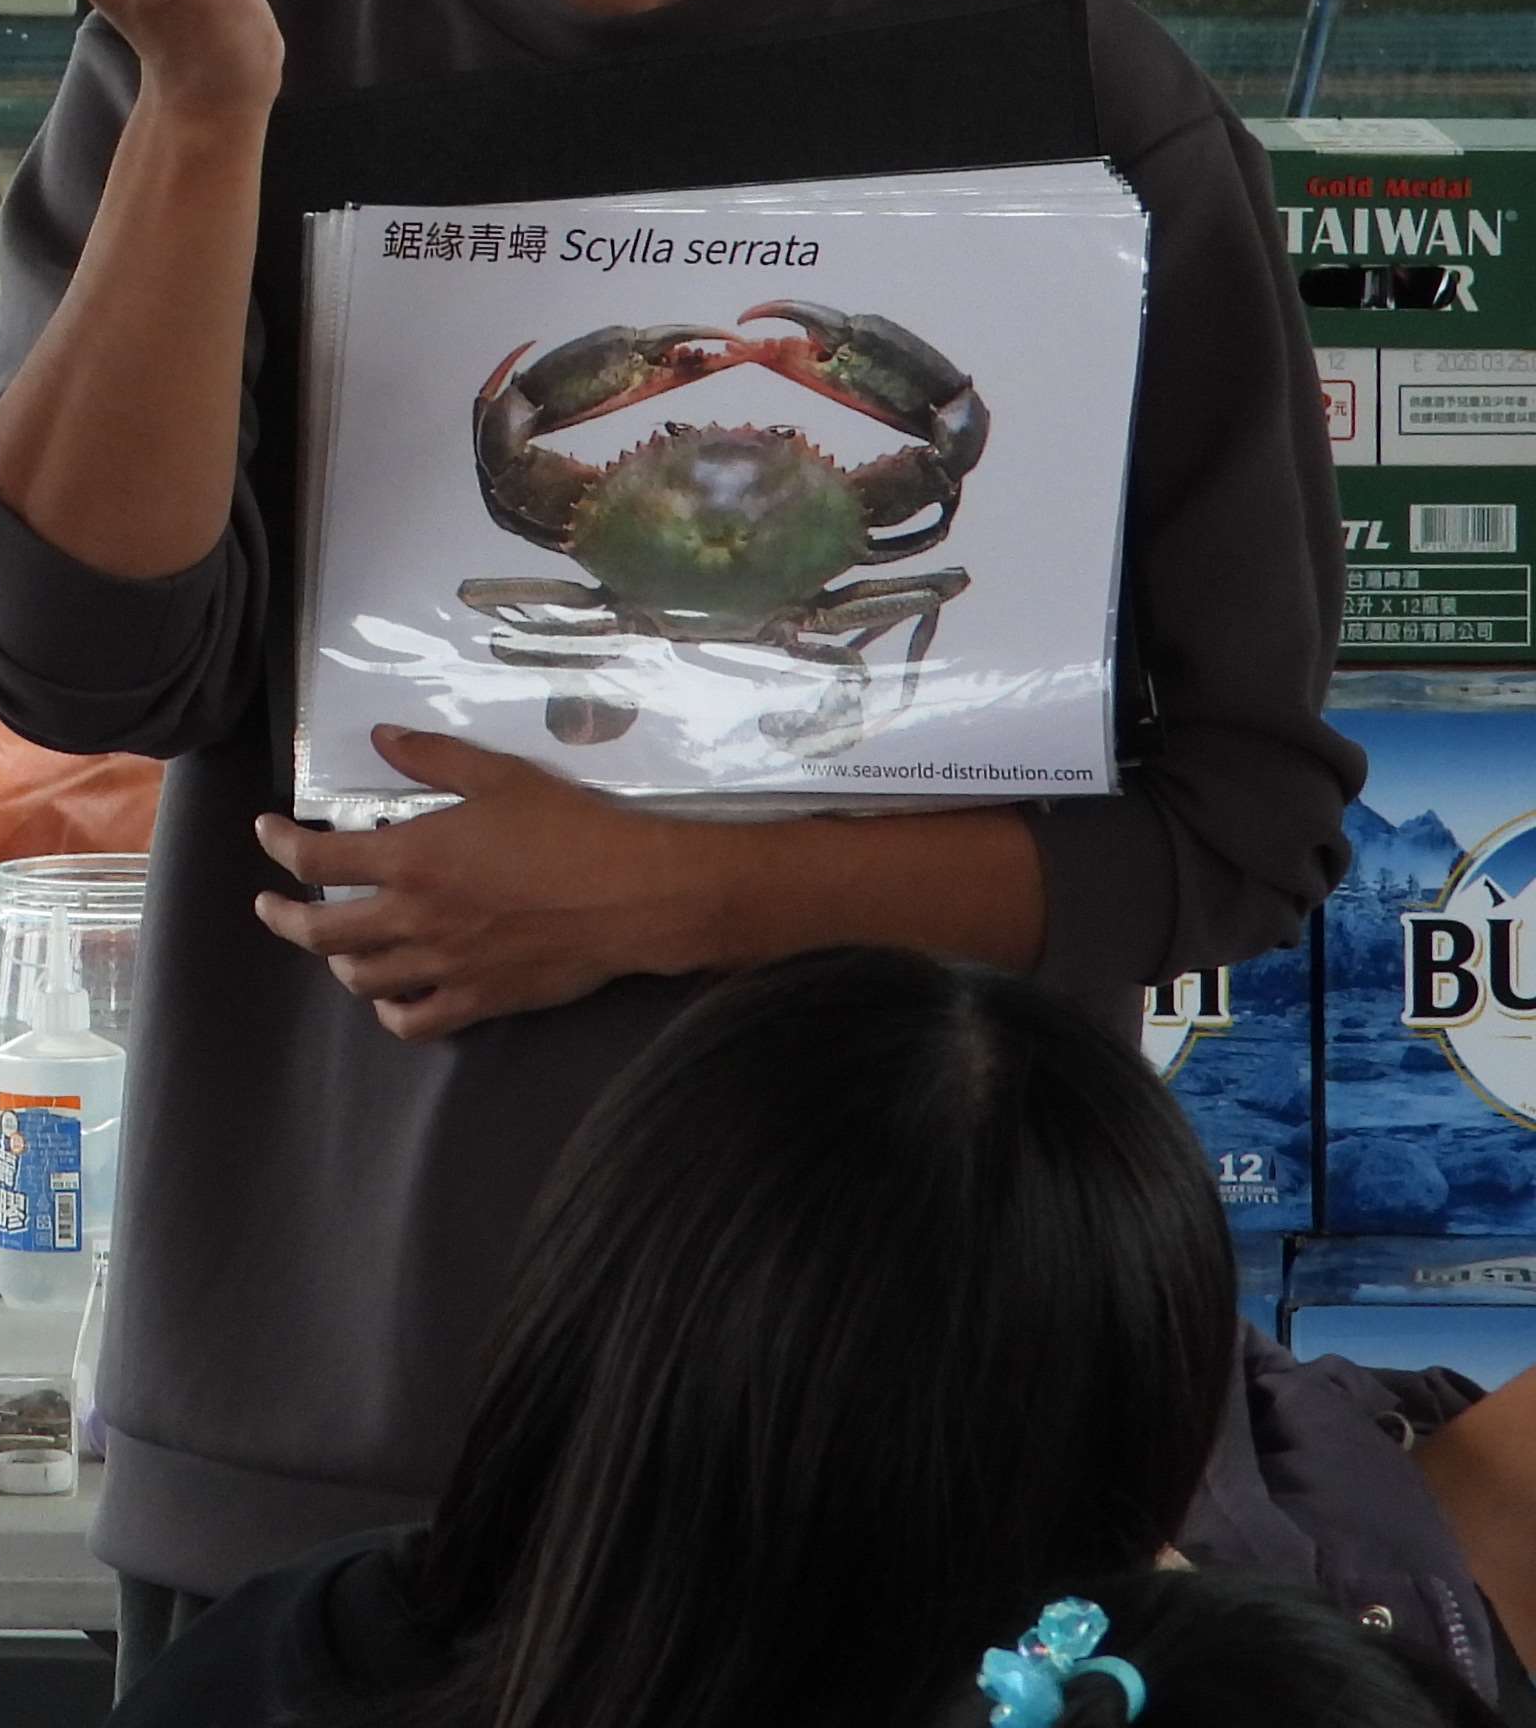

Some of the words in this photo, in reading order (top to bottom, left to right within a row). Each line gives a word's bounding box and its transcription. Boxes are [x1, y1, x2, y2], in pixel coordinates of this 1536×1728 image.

[1306, 175, 1374, 198] Gold
[1384, 176, 1473, 199] Medal
[382, 219, 549, 264] 鋸緣青蟳
[560, 227, 674, 271] Scylla
[684, 233, 821, 267] serrata
[1277, 207, 1502, 256] TAIWAN
[1340, 622, 1493, 642] 菸酒股份有限公司
[801, 762, 1094, 782] www.seaworld-distribution.com
[1218, 1153, 1264, 1183] 12
